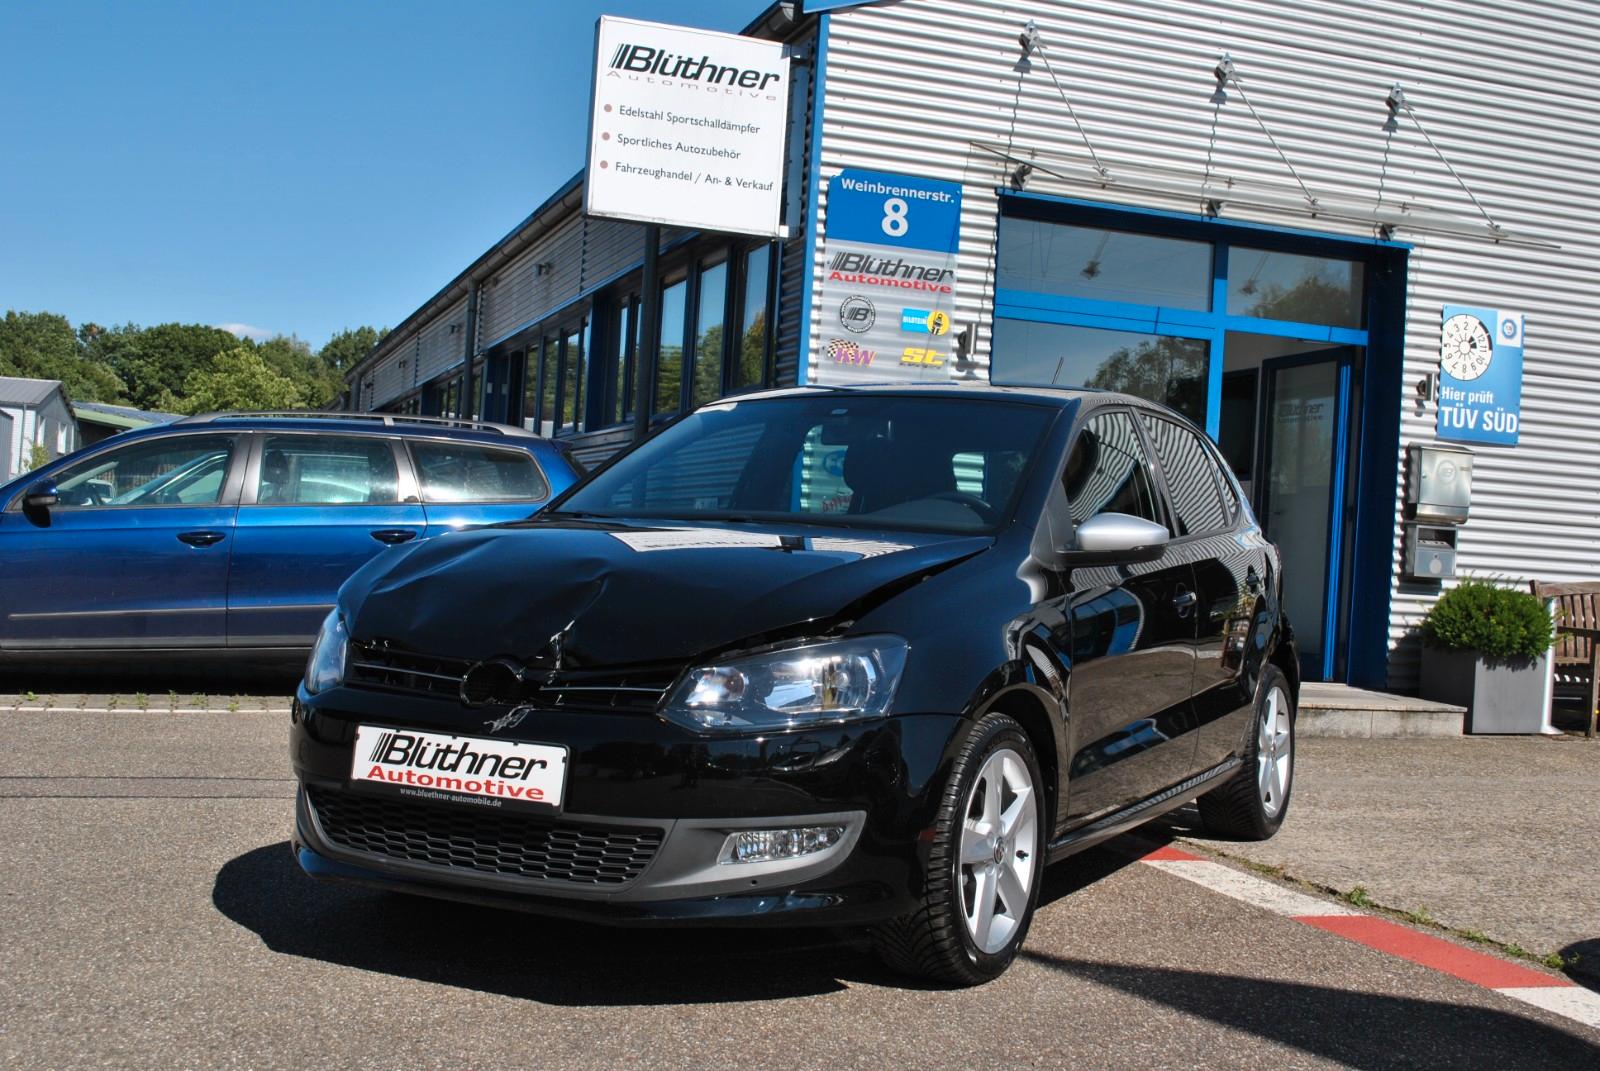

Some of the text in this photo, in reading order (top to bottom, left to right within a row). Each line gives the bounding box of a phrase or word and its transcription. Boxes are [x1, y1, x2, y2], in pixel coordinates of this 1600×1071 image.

[609, 43, 780, 91] Blüthner
[606, 70, 777, 101] Automotive
[619, 104, 761, 134] Edelstahl Sportschalldämpfer
[617, 133, 742, 160] Sportliches Autozubehör
[615, 161, 693, 183] Fahrzeughandel
[705, 174, 722, 187] An-
[724, 176, 732, 187] &
[735, 177, 774, 192] Verkauf
[841, 178, 955, 204] Weinbrennerstr.
[881, 197, 909, 237] 8
[828, 271, 953, 294] Automotive
[829, 251, 954, 283] Blüthner
[1441, 386, 1494, 405] Hier prüft
[1441, 403, 1518, 434] TÜV SÜD
[369, 732, 547, 781] Blüthner
[367, 765, 545, 801] Automotive
[399, 786, 503, 808] www.bluethner-automobile.de
